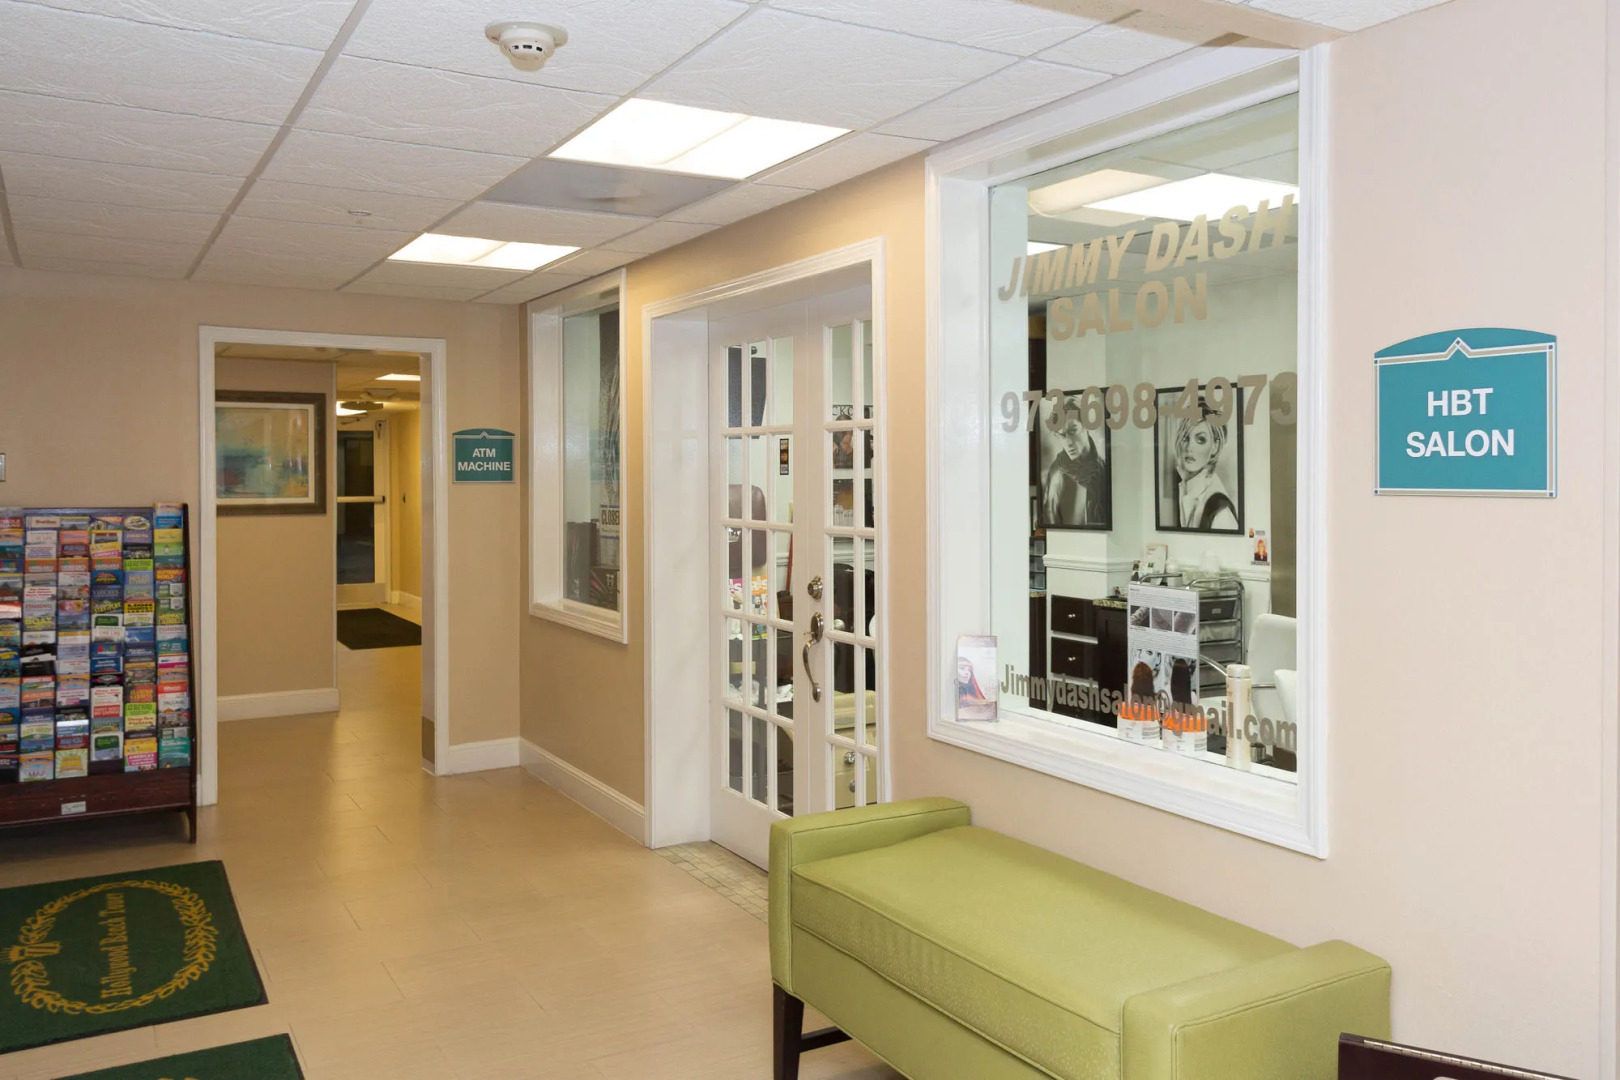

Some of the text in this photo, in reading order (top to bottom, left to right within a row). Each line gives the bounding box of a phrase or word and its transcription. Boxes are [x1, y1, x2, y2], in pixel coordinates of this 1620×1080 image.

[998, 194, 1297, 302] JIMMY DASH
[1050, 272, 1208, 341] SALON
[1427, 387, 1493, 417] HBT
[458, 462, 511, 471] MACHINE
[473, 448, 496, 458] ATM
[1406, 429, 1515, 458] SALON
[1000, 664, 1297, 754] Jimmydashsalon@gmail.com
[99, 893, 137, 998] Hollywood Beach Tower
